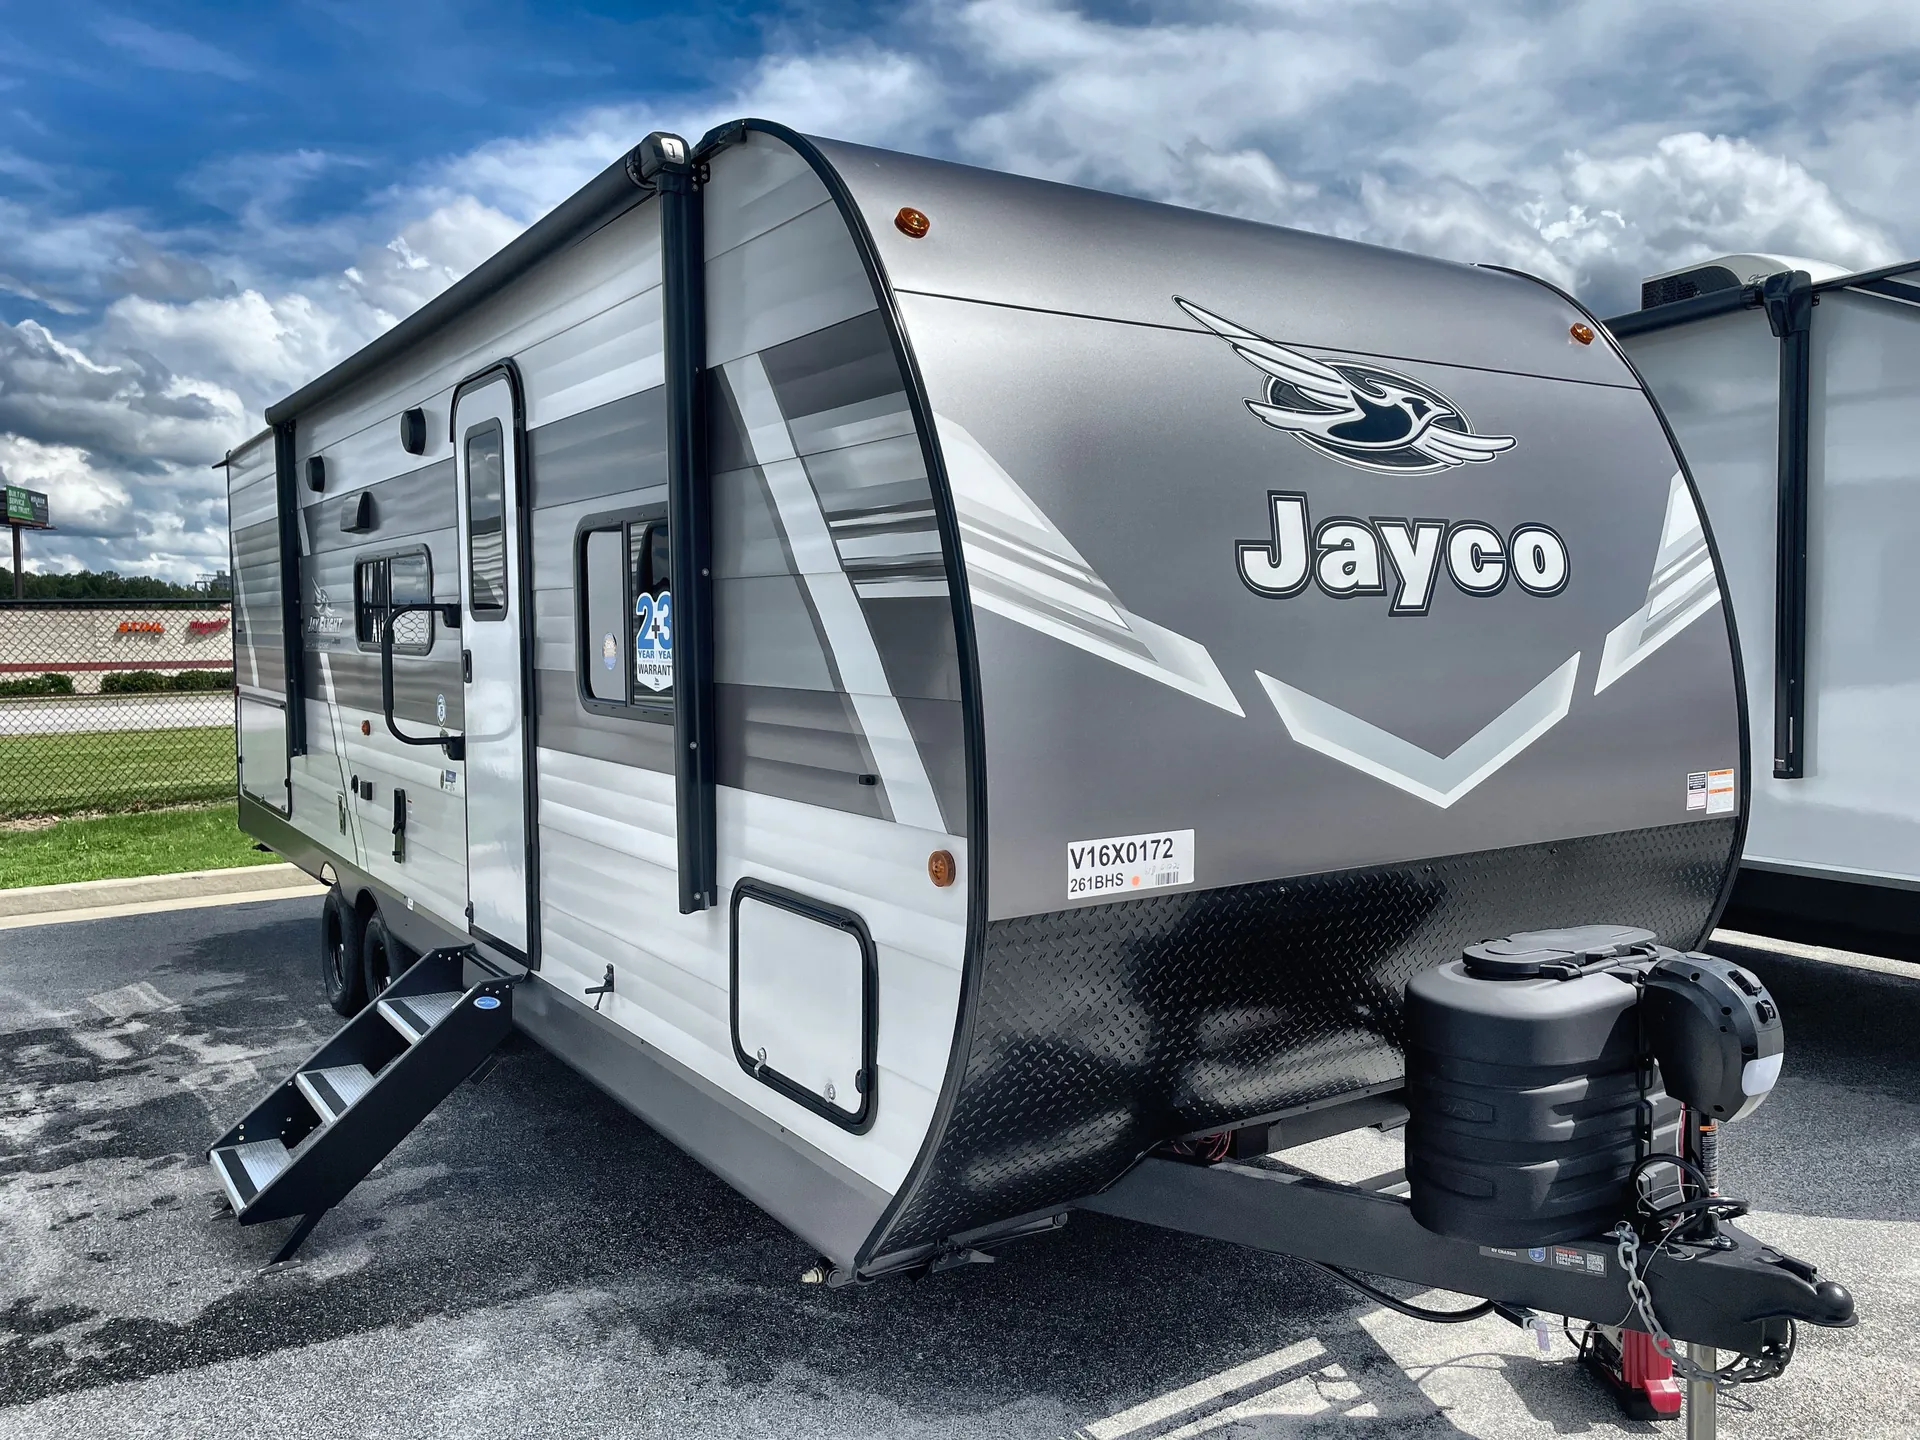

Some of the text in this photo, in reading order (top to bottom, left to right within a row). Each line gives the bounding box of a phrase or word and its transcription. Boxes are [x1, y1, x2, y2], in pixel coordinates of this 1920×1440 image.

[9, 497, 25, 506] SERVICE
[1235, 490, 1571, 616] Jayco
[308, 616, 343, 633] JAY FLIGHT
[638, 650, 673, 660] YEAR YEA
[1070, 838, 1173, 869] V16X0172
[1070, 873, 1124, 893] 261BHS
